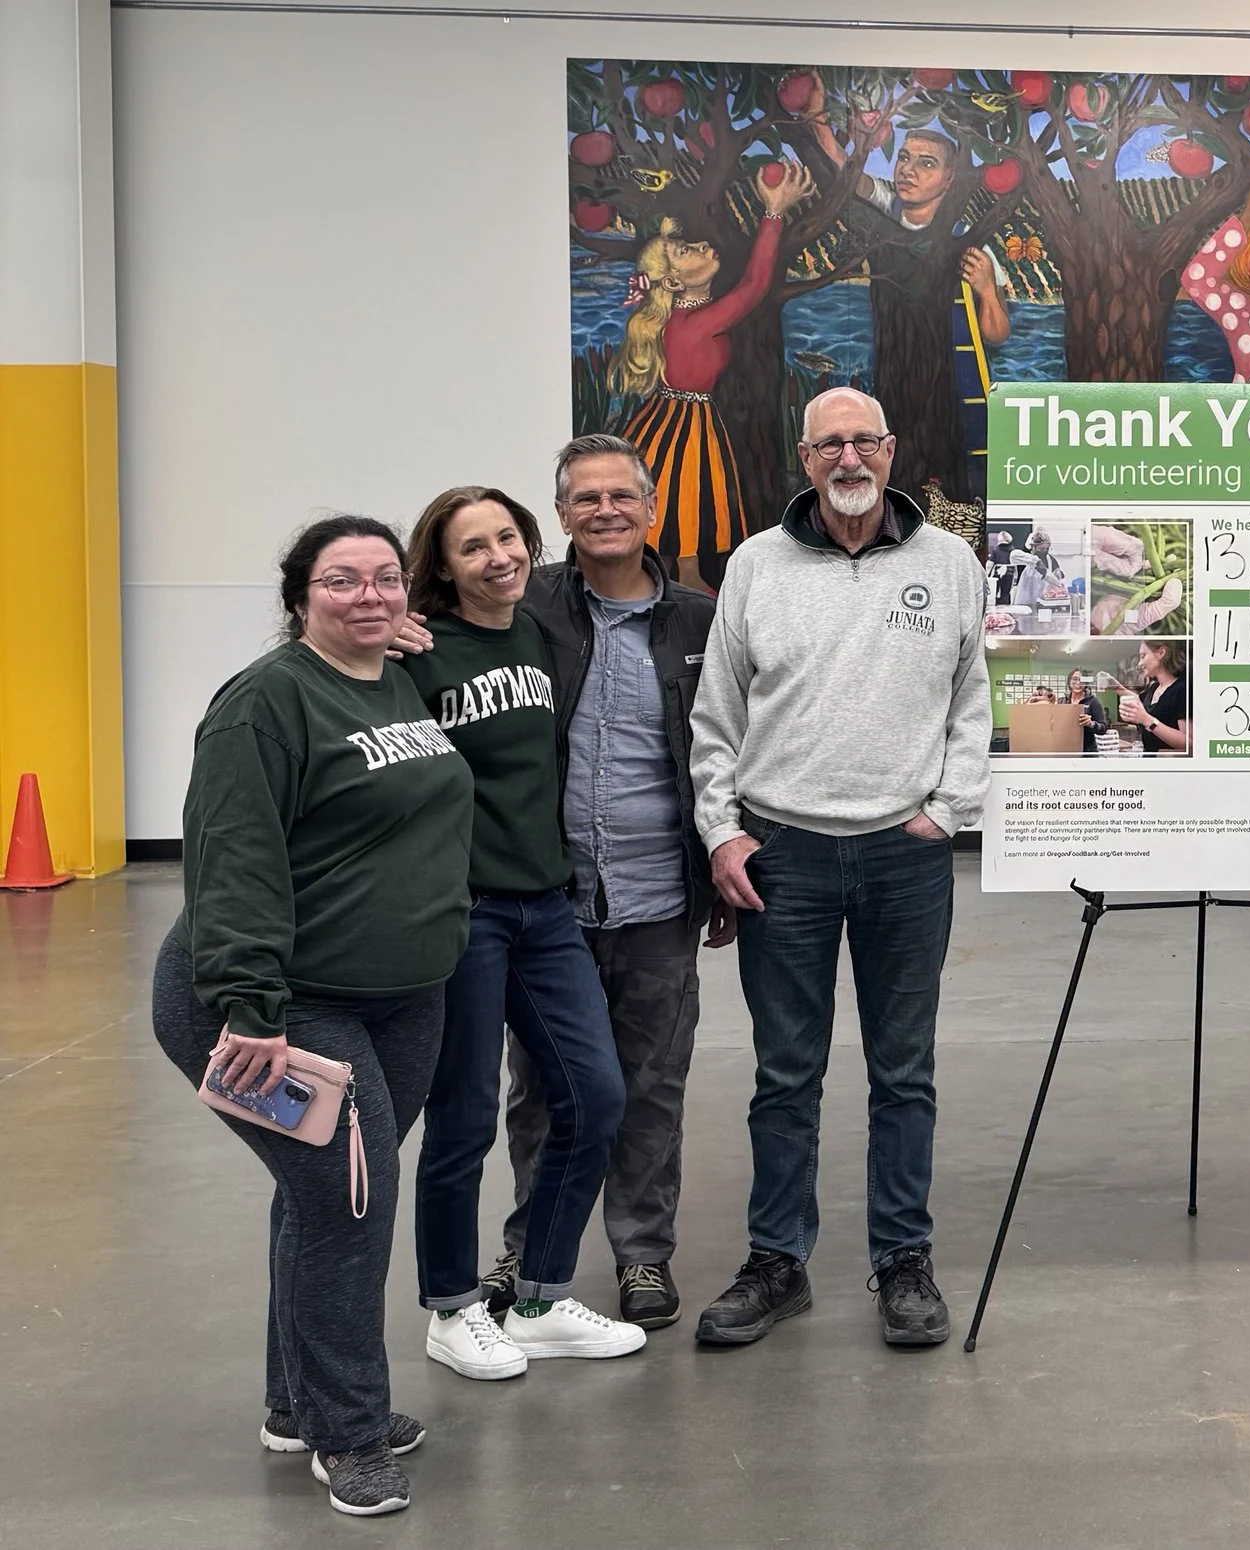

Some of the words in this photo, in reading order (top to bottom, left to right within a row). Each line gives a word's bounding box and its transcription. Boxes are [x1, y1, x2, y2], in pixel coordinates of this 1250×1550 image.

[1005, 395, 1192, 448] Thank
[1004, 457, 1047, 485] for
[1055, 458, 1241, 492] volunteering
[1211, 519, 1232, 531] We
[886, 611, 934, 632] JUNIATA
[1006, 788, 1049, 798] Together,
[1089, 788, 1107, 796] end
[1110, 788, 1144, 798] hunger
[1005, 801, 1023, 809] and
[1026, 801, 1038, 809] its
[1101, 800, 1115, 809] for
[1118, 800, 1145, 811] good.
